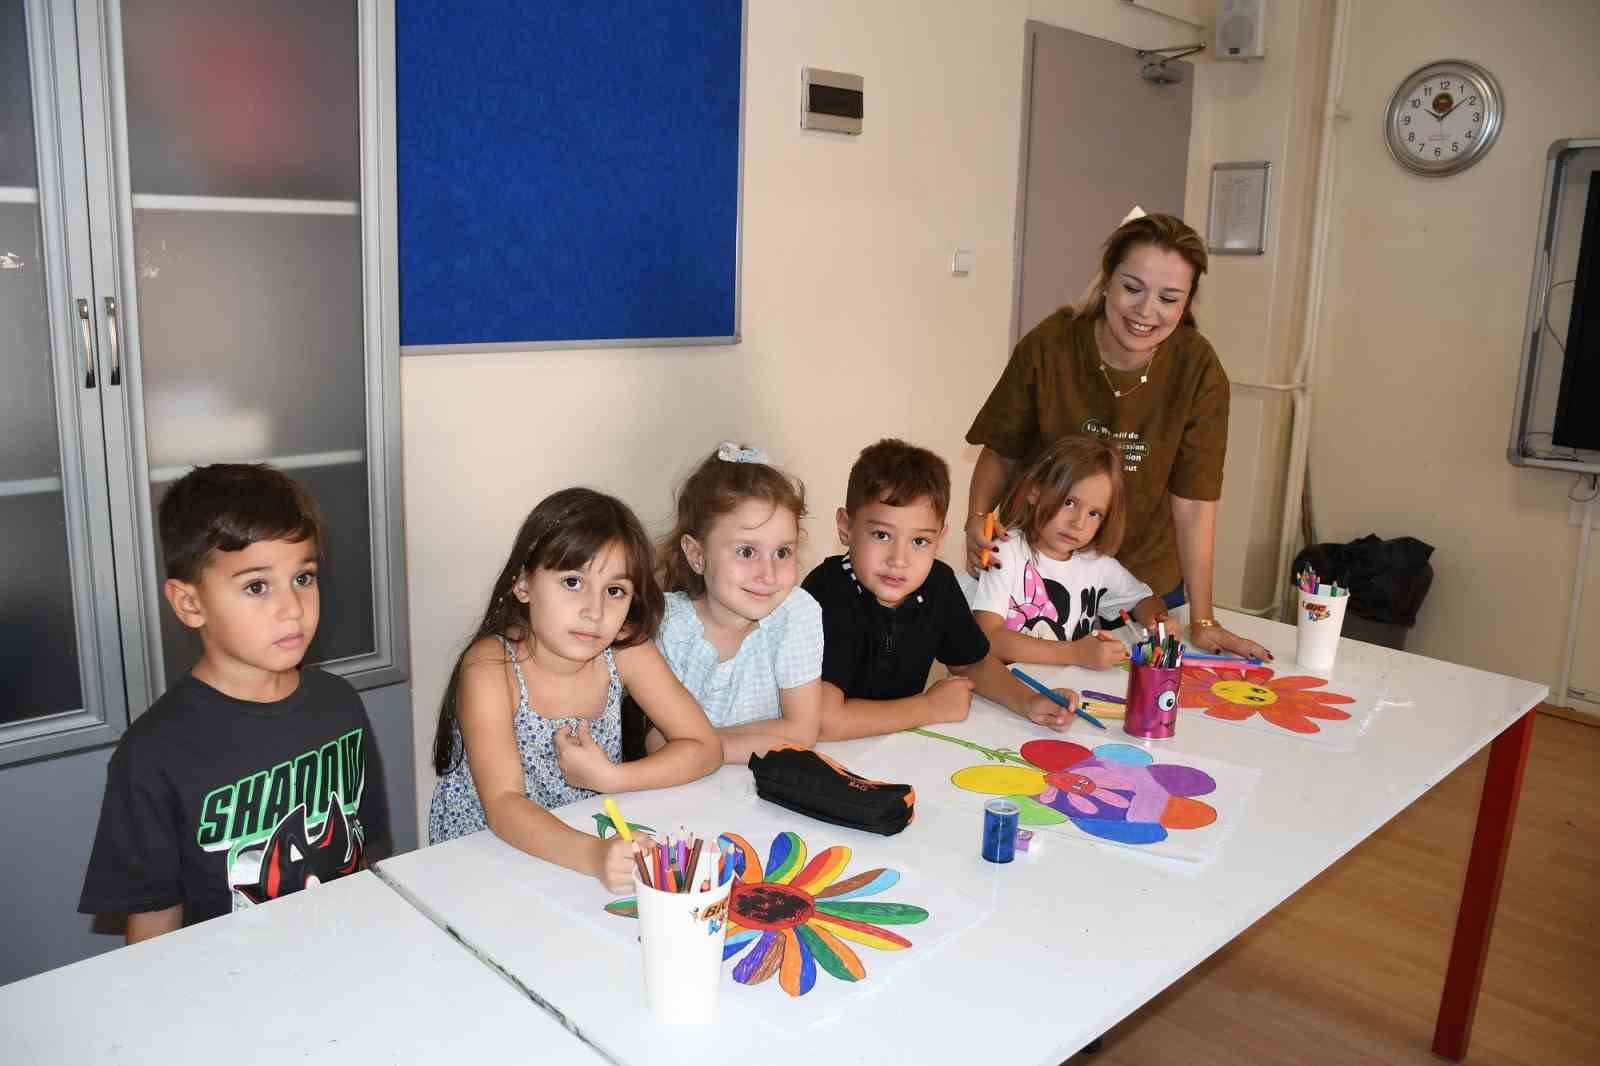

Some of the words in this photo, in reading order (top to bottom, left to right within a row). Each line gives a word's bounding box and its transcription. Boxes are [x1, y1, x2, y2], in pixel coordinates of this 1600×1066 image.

[1440, 81, 1450, 90] 12
[1424, 87, 1432, 97] 11
[1411, 99, 1421, 109] 10
[1469, 96, 1477, 106] 2
[1404, 116, 1411, 126] 9
[1472, 112, 1480, 122] 3
[1408, 132, 1415, 142] 8
[1465, 130, 1472, 139] 4
[1418, 143, 1425, 153] 7
[1434, 147, 1441, 157] 6
[1451, 142, 1458, 152] 5
